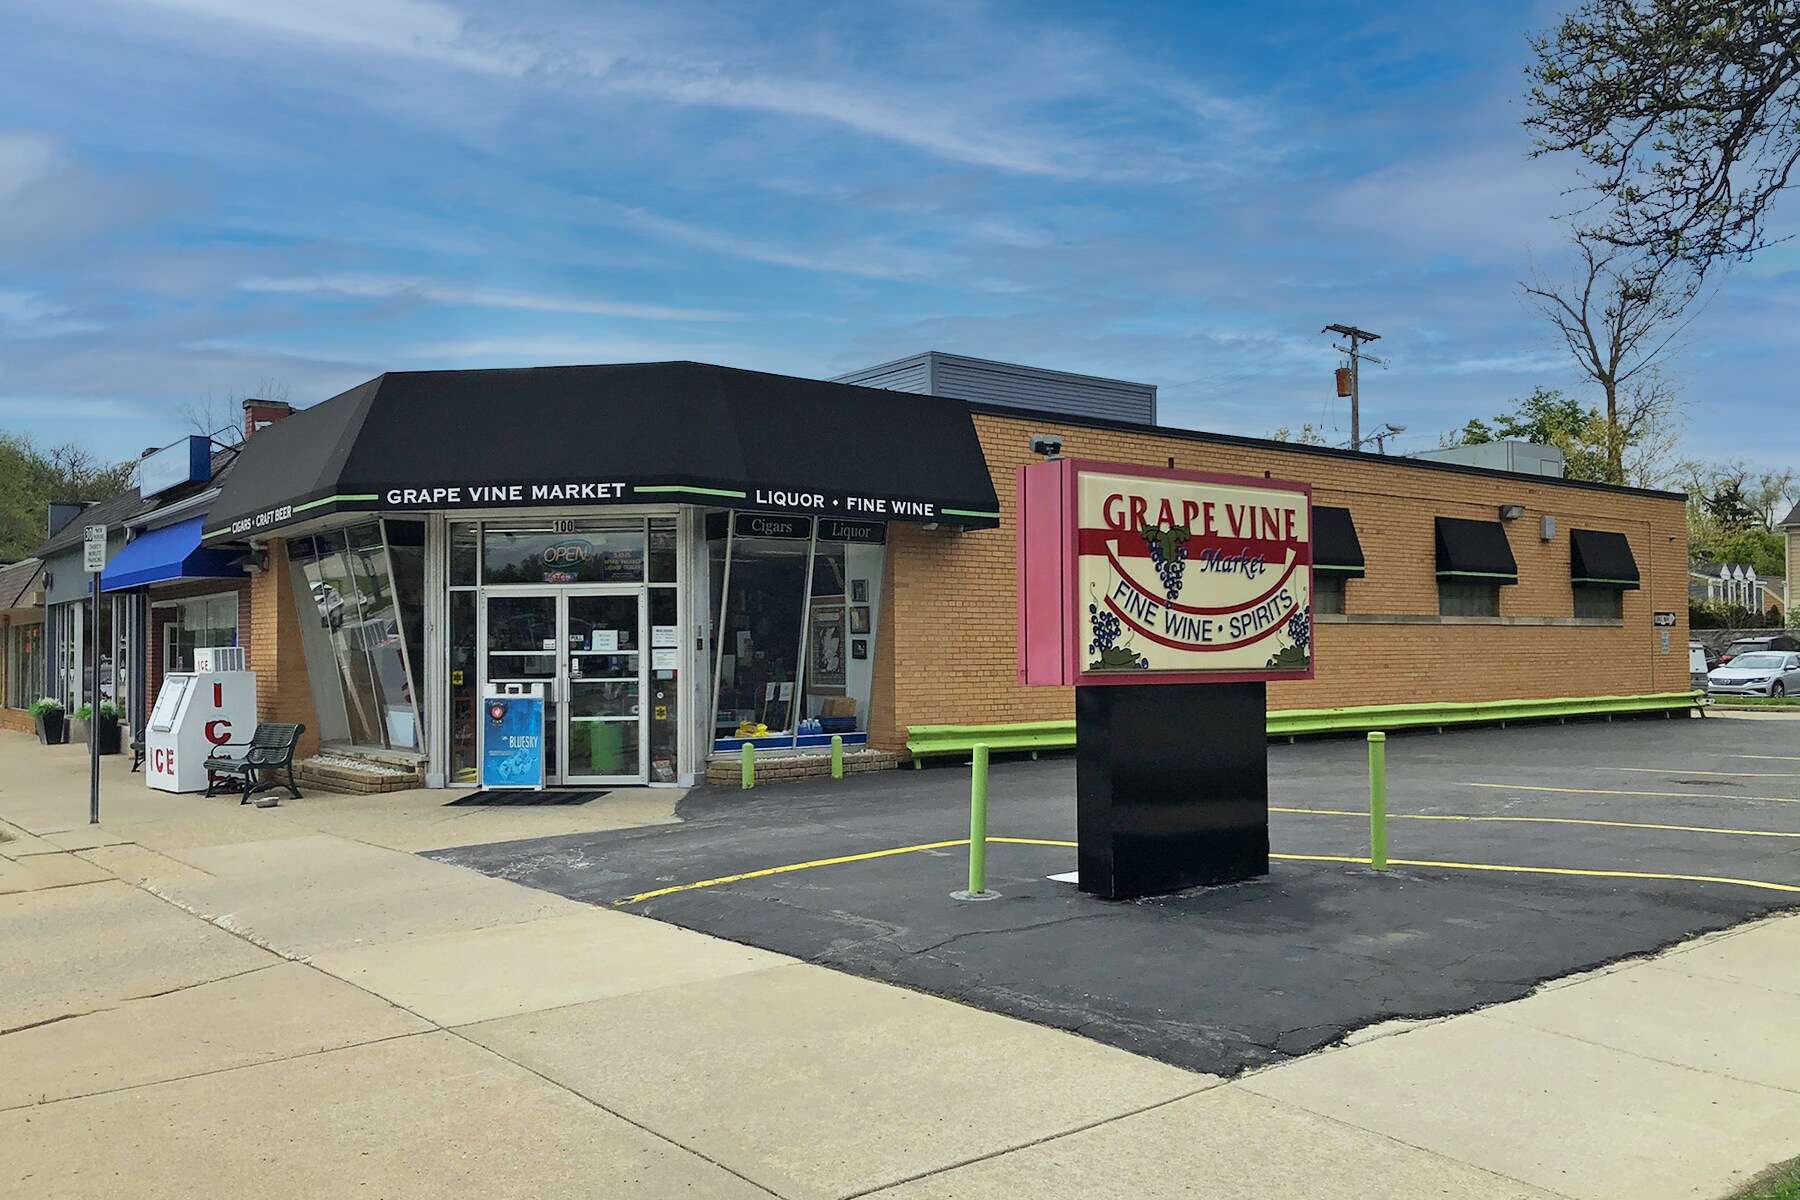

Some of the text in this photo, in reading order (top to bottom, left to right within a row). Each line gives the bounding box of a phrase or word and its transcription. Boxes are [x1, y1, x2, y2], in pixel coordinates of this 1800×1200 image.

[387, 482, 626, 504] GRAPE VINE MARKET
[756, 490, 934, 516] LIQUOR FINE WINE
[232, 505, 292, 534] CIGARS CRAFT BEER
[553, 520, 574, 532] 100
[751, 518, 793, 534] Cigars
[1103, 493, 1298, 541] GRAPE VINE
[85, 526, 93, 541] 30
[832, 522, 871, 540] Liquor
[543, 546, 588, 562] OPEN
[1200, 547, 1266, 579] Market
[1113, 580, 1293, 642] FINE WINE SPIRITS
[198, 660, 208, 671] ICE
[150, 747, 174, 775] ICE
